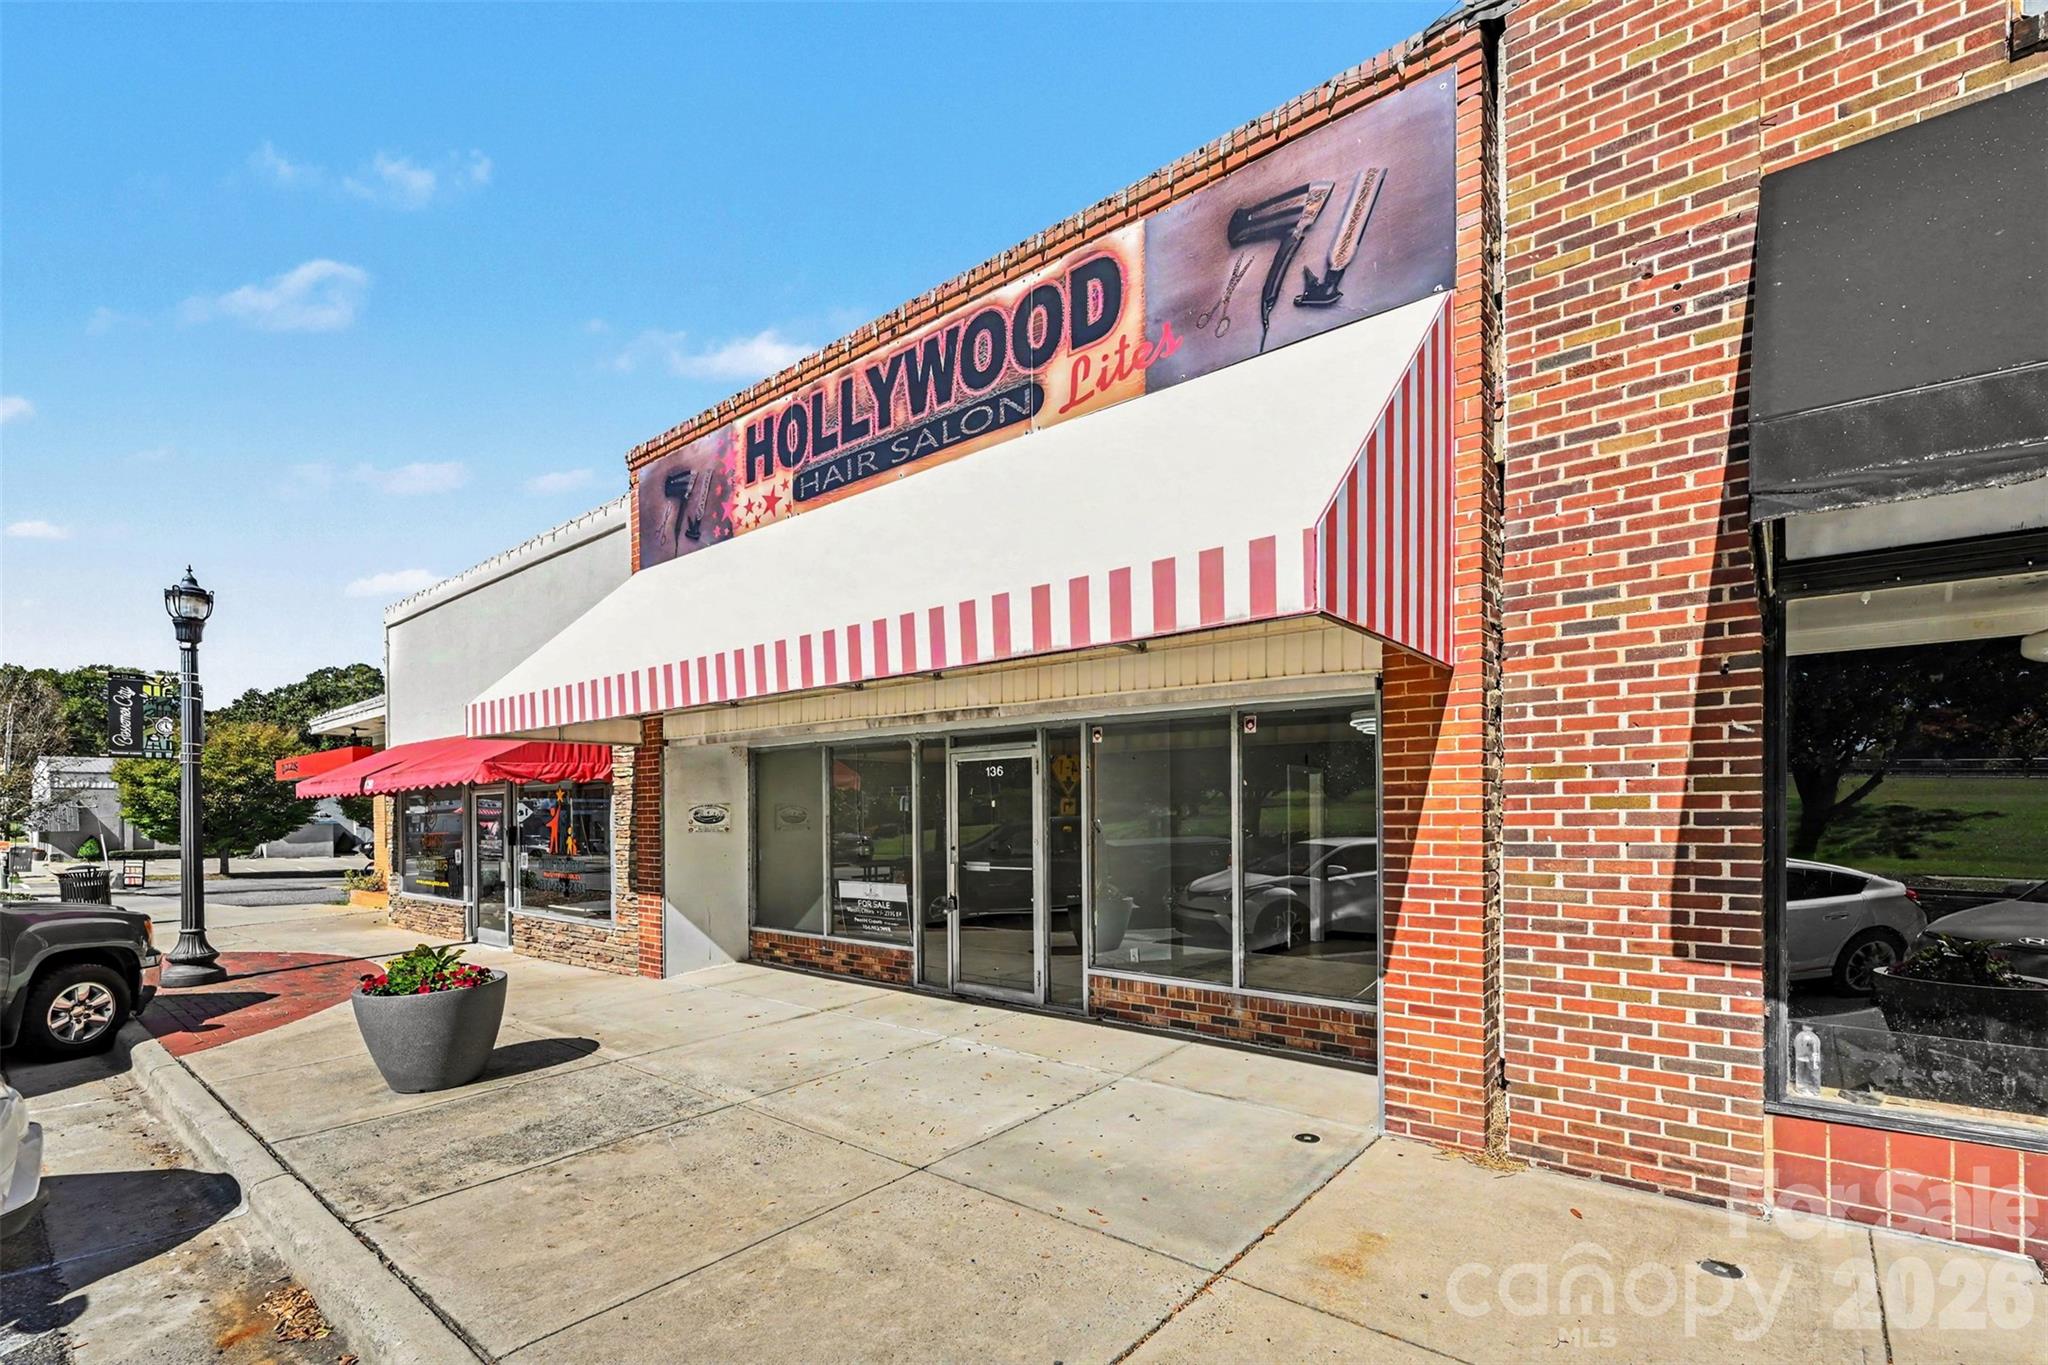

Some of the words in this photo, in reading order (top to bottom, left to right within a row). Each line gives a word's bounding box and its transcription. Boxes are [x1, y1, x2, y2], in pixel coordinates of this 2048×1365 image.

[744, 254, 1124, 486] HOLLYWOOD
[1059, 321, 1184, 414] Lites
[799, 450, 879, 499] HAIR
[890, 386, 1031, 463] SALON
[112, 685, 136, 707] City
[985, 765, 1004, 777] 136
[857, 899, 873, 909] FOR
[873, 901, 891, 910] SALE
